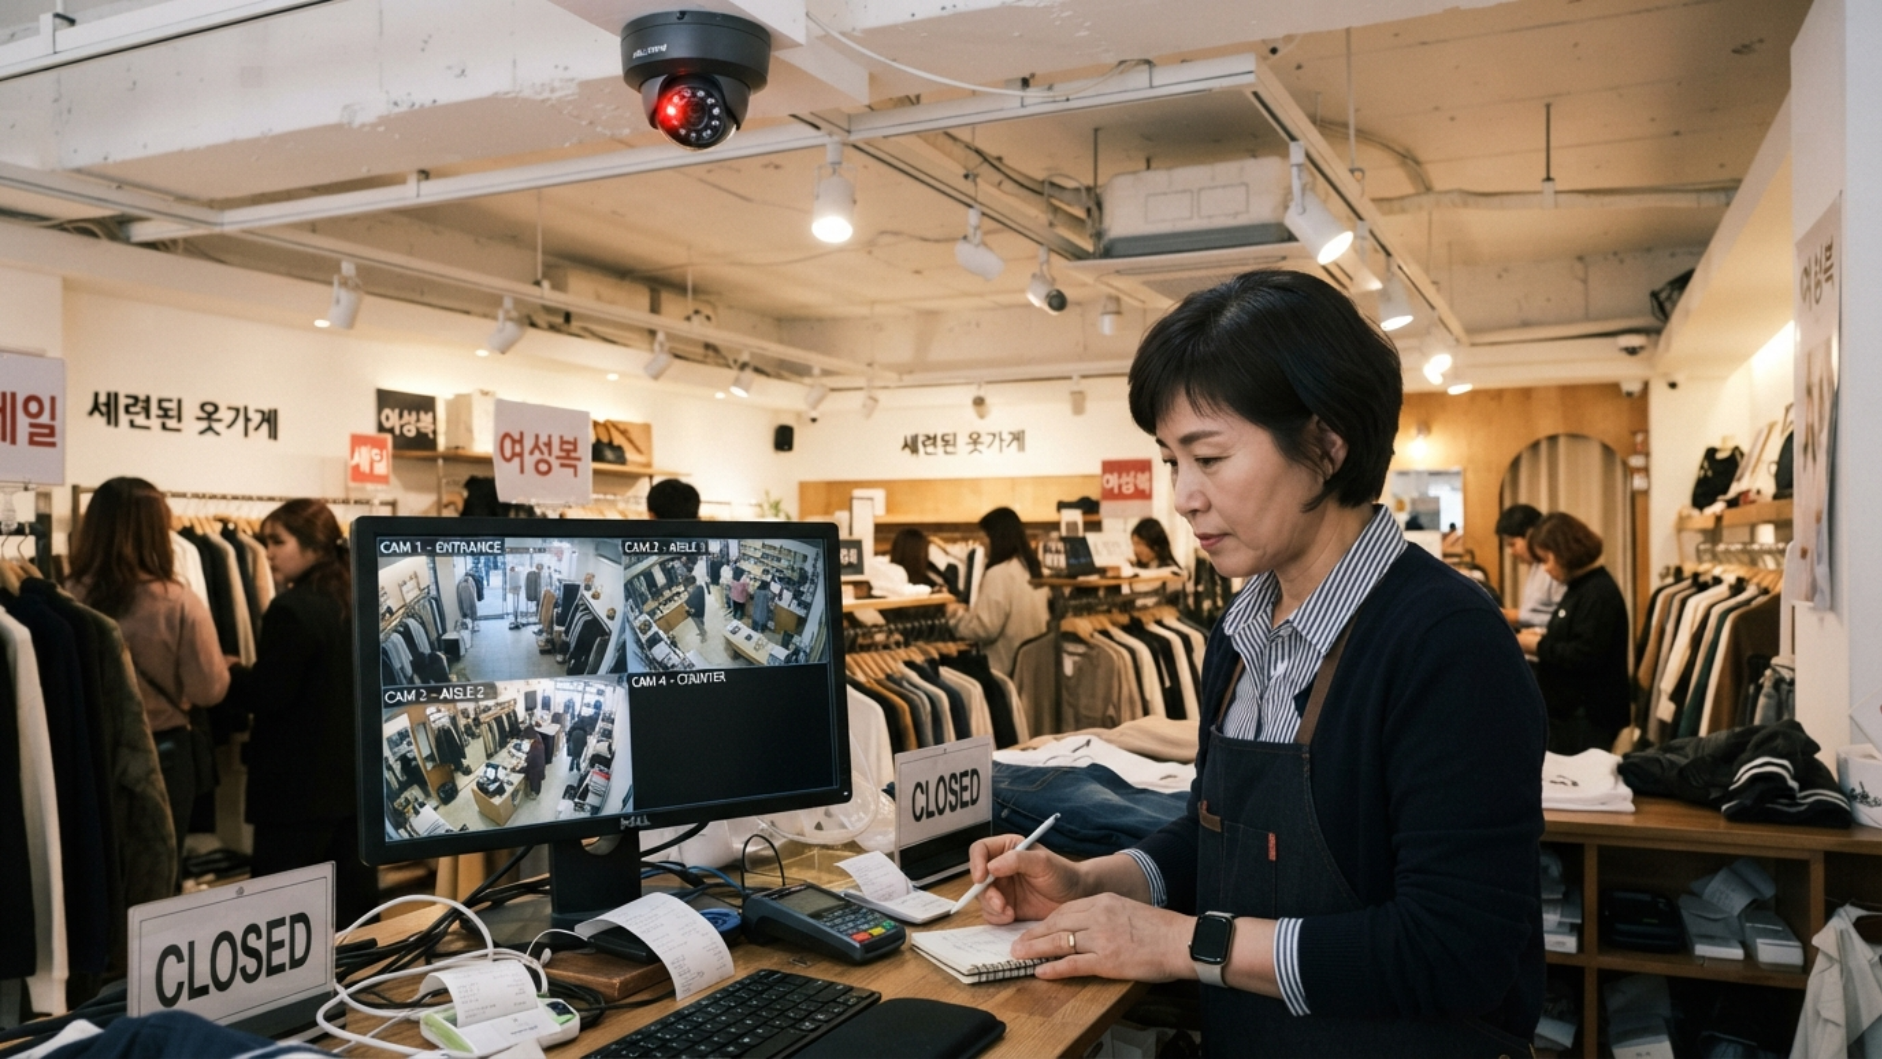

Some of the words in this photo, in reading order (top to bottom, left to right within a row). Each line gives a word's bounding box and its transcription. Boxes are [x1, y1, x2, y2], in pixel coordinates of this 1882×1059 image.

[88, 391, 182, 432] 세련된
[195, 401, 279, 441] 옷가게
[500, 430, 582, 478] 여성복
[965, 430, 1026, 455] 옷가게
[380, 541, 412, 554] CAM
[415, 541, 422, 553] 1
[435, 541, 502, 554] ENTRANCE
[624, 541, 650, 553] CAM
[631, 676, 657, 688] CAM
[384, 689, 416, 704] CAM
[420, 689, 428, 702] 2
[477, 686, 485, 698] 2
[912, 768, 981, 823] CLOSED
[155, 911, 313, 1009] CLOSED
